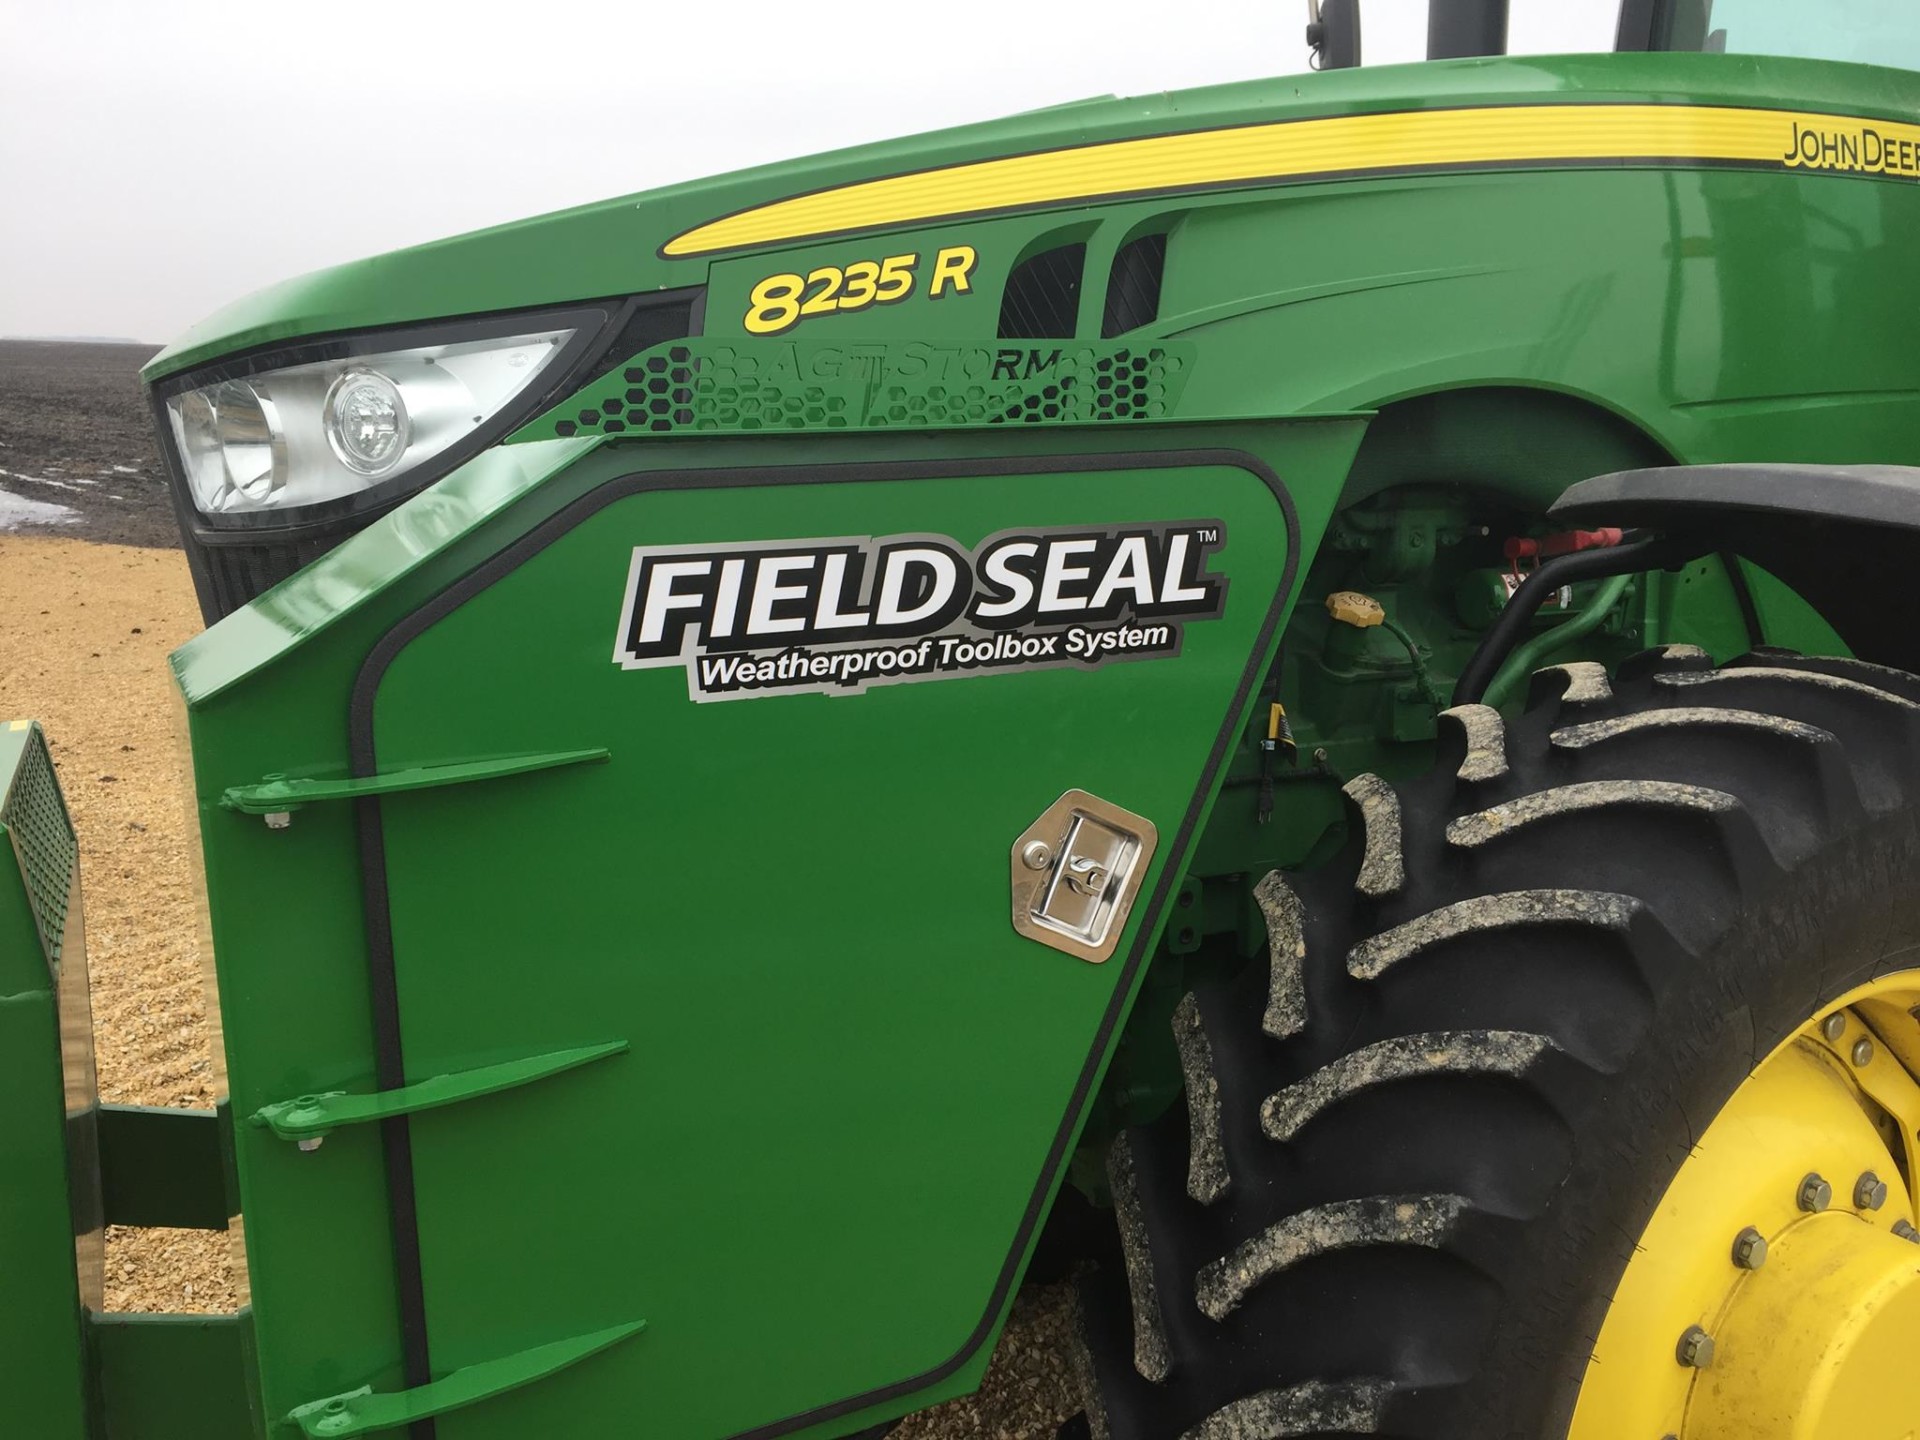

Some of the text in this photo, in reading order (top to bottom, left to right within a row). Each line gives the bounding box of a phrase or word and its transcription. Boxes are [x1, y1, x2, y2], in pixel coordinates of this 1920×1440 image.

[1784, 121, 1859, 165] JOHN
[743, 245, 977, 335] 8235 R
[638, 548, 957, 644] FIELD
[974, 533, 1207, 618] SEAL
[701, 625, 1169, 686] Weatherproof Toolbox System
